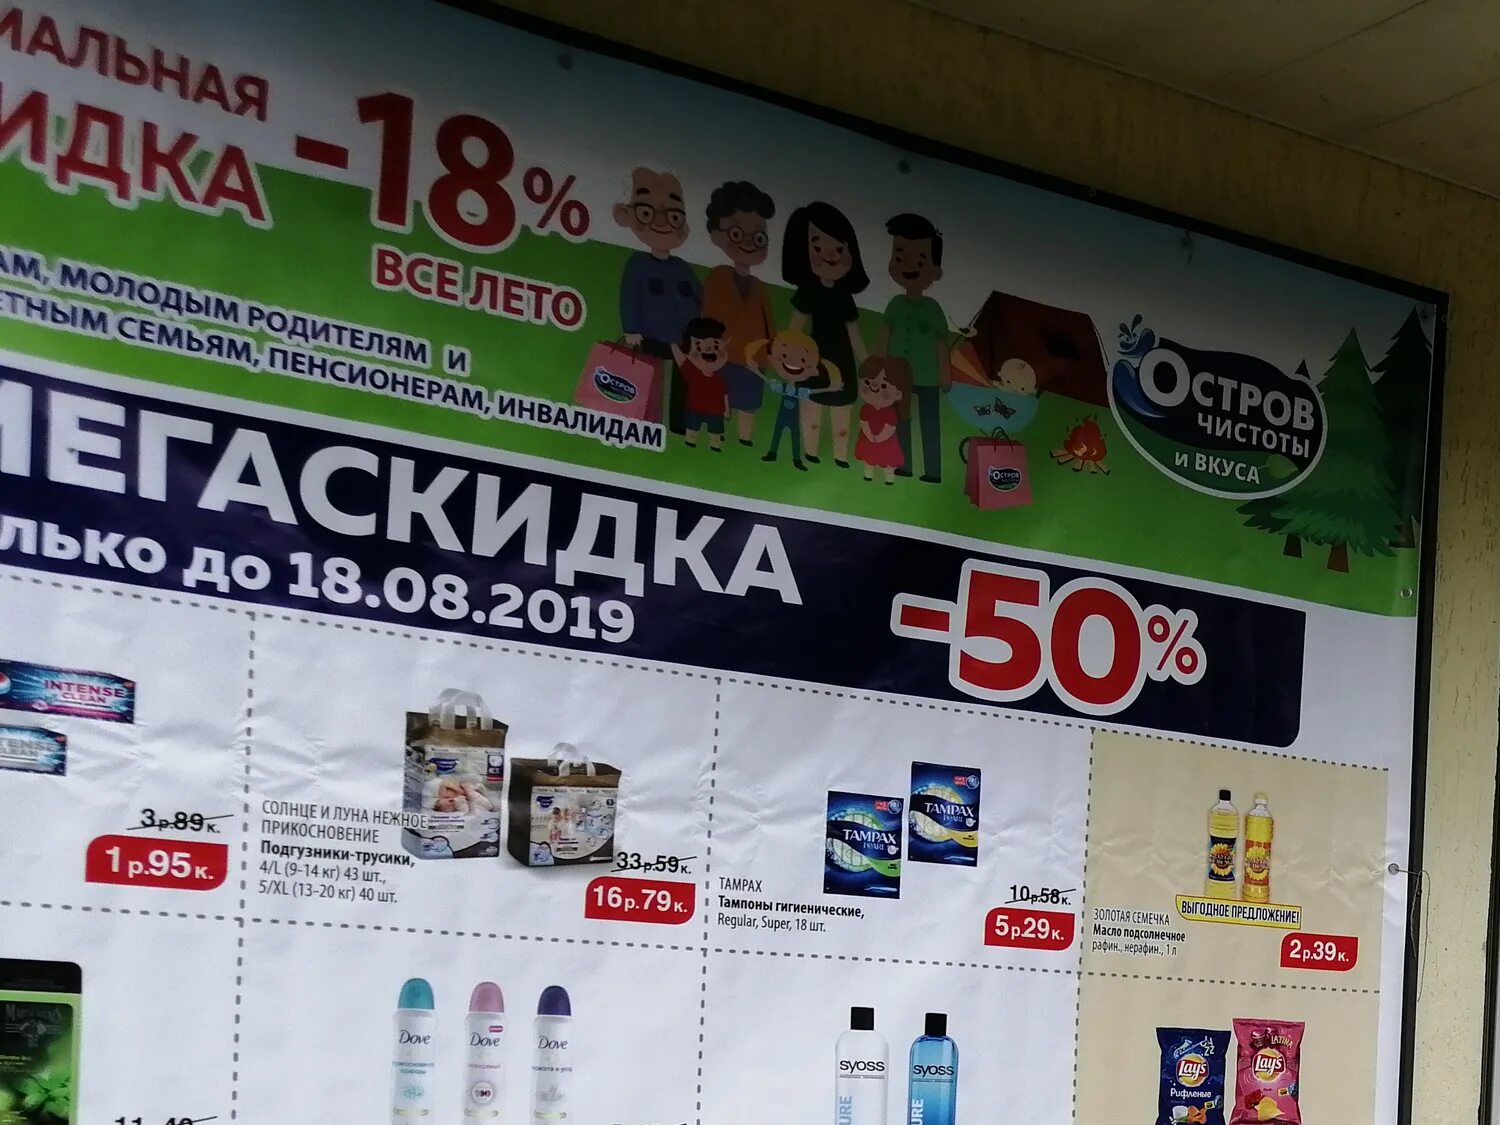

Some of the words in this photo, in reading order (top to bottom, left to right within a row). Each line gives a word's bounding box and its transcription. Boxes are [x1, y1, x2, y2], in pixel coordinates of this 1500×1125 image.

[375, 249, 460, 300] ВСЕ
[469, 272, 583, 327] ЛЕТО
[60, 264, 239, 322] МОЛОДЫМ
[248, 305, 427, 363] РОДИТЕЛЯМ
[447, 350, 466, 372] И
[0, 290, 109, 333] ТНЫМ
[118, 316, 259, 368] СЕМЬЯМ,
[269, 346, 491, 413] ПЕНСИОНЕРАМ,
[498, 395, 663, 448] ИНВАЛИДАМ
[1197, 412, 1309, 458] ЧИСТОТЫ
[1195, 453, 1261, 485] ВКУСА
[182, 546, 271, 594] до
[288, 552, 636, 643] 18.08.2019
[899, 570, 1199, 706] -50%
[44, 679, 126, 699] INTENSE
[262, 800, 317, 819] СОЛНЦЕ
[333, 806, 369, 823] ЛУНА
[373, 810, 427, 829] НЕЖНОЕ
[924, 802, 974, 818] TAMPAX
[261, 820, 379, 843] ПРИКОСНОВЕНИЕ
[842, 828, 897, 845] TAMPAX
[260, 840, 415, 868] Подгузники-трусики,
[259, 861, 281, 875] 4/L
[322, 865, 340, 881] кг)
[344, 866, 359, 881] 43
[258, 879, 289, 896] 5/XL
[338, 884, 355, 902] кг)
[359, 887, 374, 901] 40
[378, 890, 398, 903] шт.
[719, 876, 762, 893] TAMPAX
[718, 895, 773, 912] Тампоны
[775, 901, 865, 919] гигиенические,
[1094, 907, 1131, 924] ЗОЛОТАЯ
[1132, 911, 1170, 926] СЕМЕЧКА
[1181, 900, 1230, 918] ВЫГОДНОЕ
[1231, 905, 1300, 924] ПРЕДЛОЖЕНИЕ!
[718, 912, 759, 929] Regular,
[761, 916, 792, 932] Super,
[795, 918, 807, 931] 18
[809, 920, 827, 933] шт.
[1093, 924, 1122, 939] Масло
[1123, 929, 1186, 943] подсолнечное
[399, 1029, 431, 1046] Dove
[470, 1032, 501, 1048] Dove
[1178, 1060, 1207, 1080] Lay's
[1255, 1055, 1283, 1076] Lay's
[1170, 1088, 1212, 1100] Рифленые
